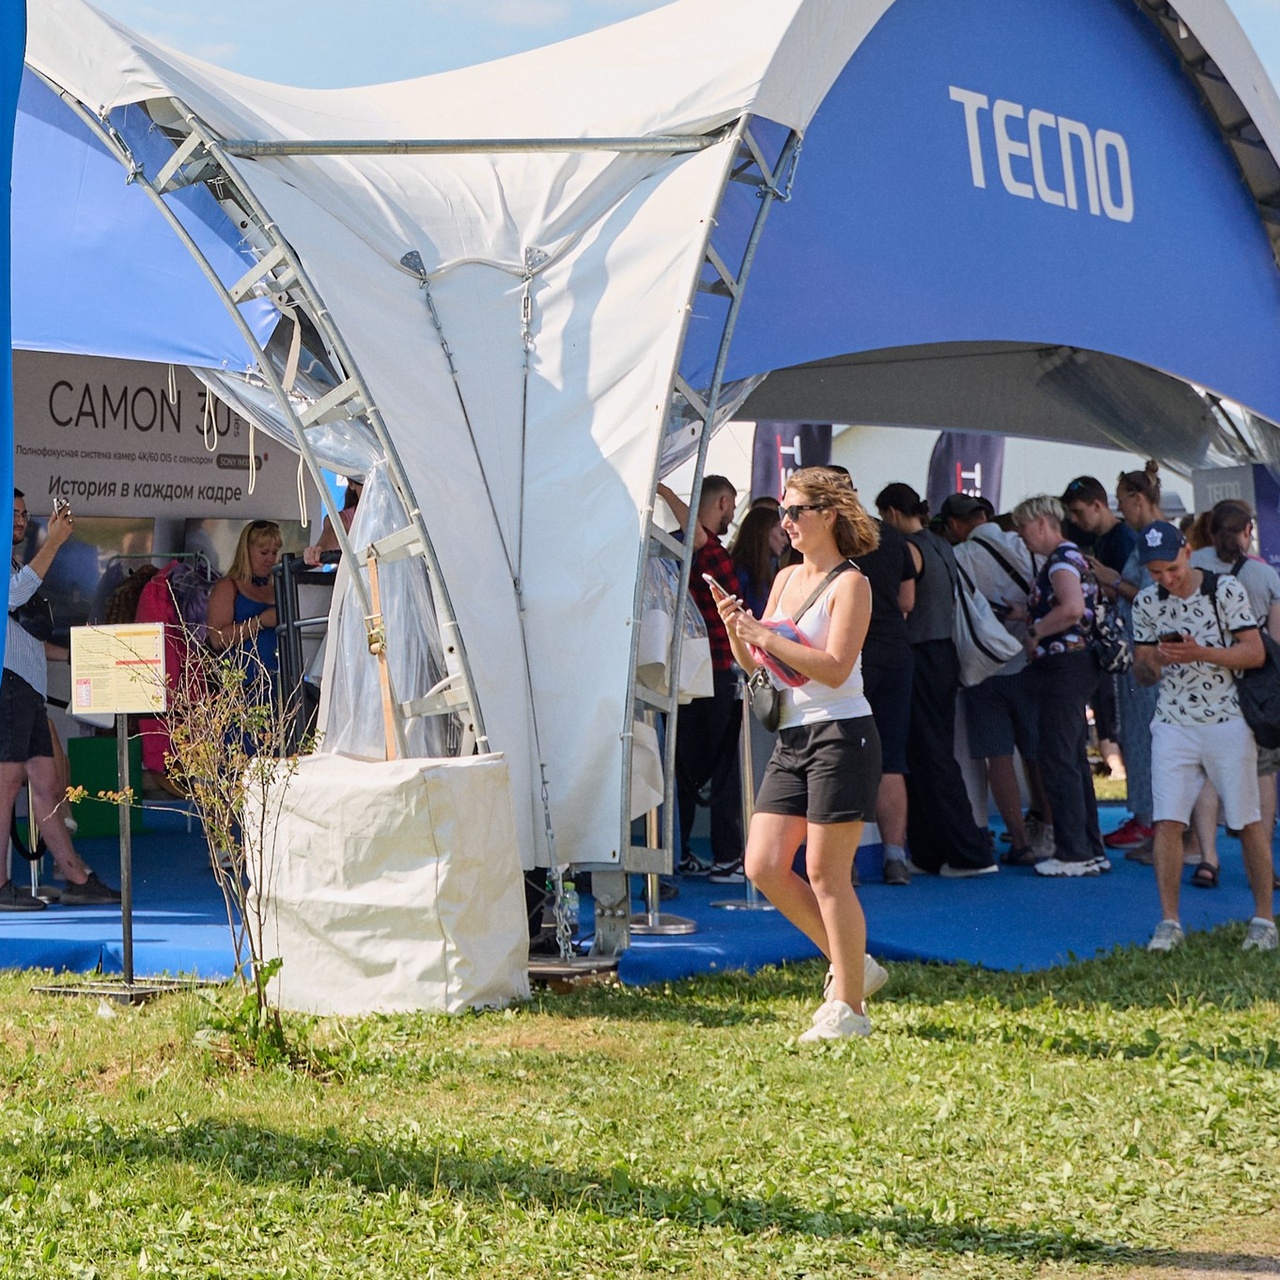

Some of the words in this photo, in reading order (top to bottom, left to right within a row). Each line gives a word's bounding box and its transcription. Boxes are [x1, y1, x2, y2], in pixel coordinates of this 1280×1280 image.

[949, 86, 1133, 222] TECNO
[49, 380, 181, 433] CAMON
[16, 444, 79, 460] Полнофокусная
[79, 450, 112, 460] система
[113, 452, 136, 463] камер
[178, 455, 214, 465] сенсором
[48, 475, 117, 501] История
[120, 483, 130, 497] в
[133, 483, 194, 501] каждом
[198, 486, 242, 505] кадре
